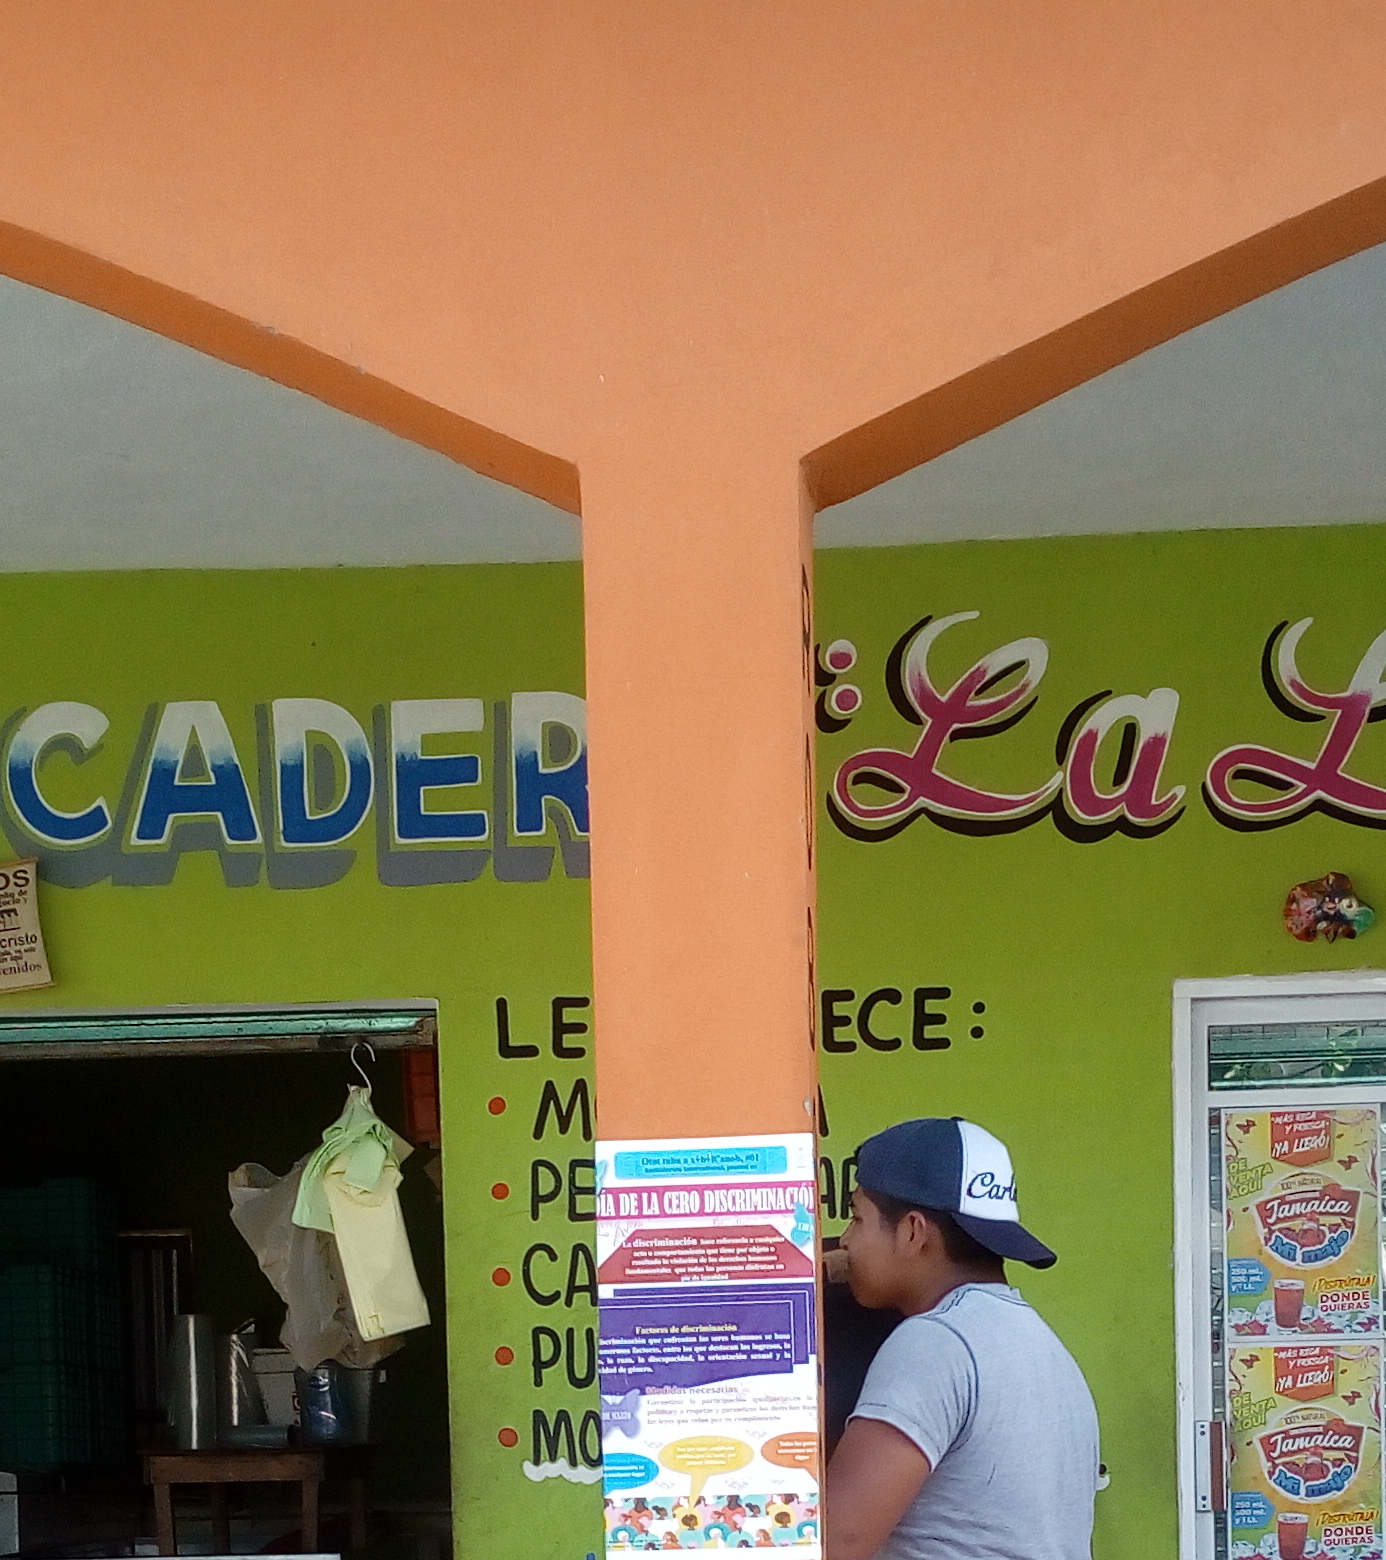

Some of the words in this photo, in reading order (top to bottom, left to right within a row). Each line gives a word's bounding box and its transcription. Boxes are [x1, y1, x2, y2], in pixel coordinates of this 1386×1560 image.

[496, 996, 590, 1059] LE
[1229, 1162, 1273, 1185] VENTA
[597, 1190, 616, 1216] ÍA
[619, 1192, 638, 1216] DE
[642, 1192, 660, 1215] LA
[664, 1190, 700, 1214] CERO
[1266, 1196, 1352, 1223] Jamaica
[633, 1237, 698, 1248] discriminación
[1320, 1290, 1371, 1304] DONDE
[1320, 1301, 1370, 1313] QUIERAS
[689, 1385, 739, 1395] necesarias
[1233, 1397, 1277, 1420] VENTA
[1270, 1430, 1356, 1457] Jamaica
[1324, 1525, 1374, 1538] DONDE
[1324, 1535, 1374, 1547] QUIERAS
